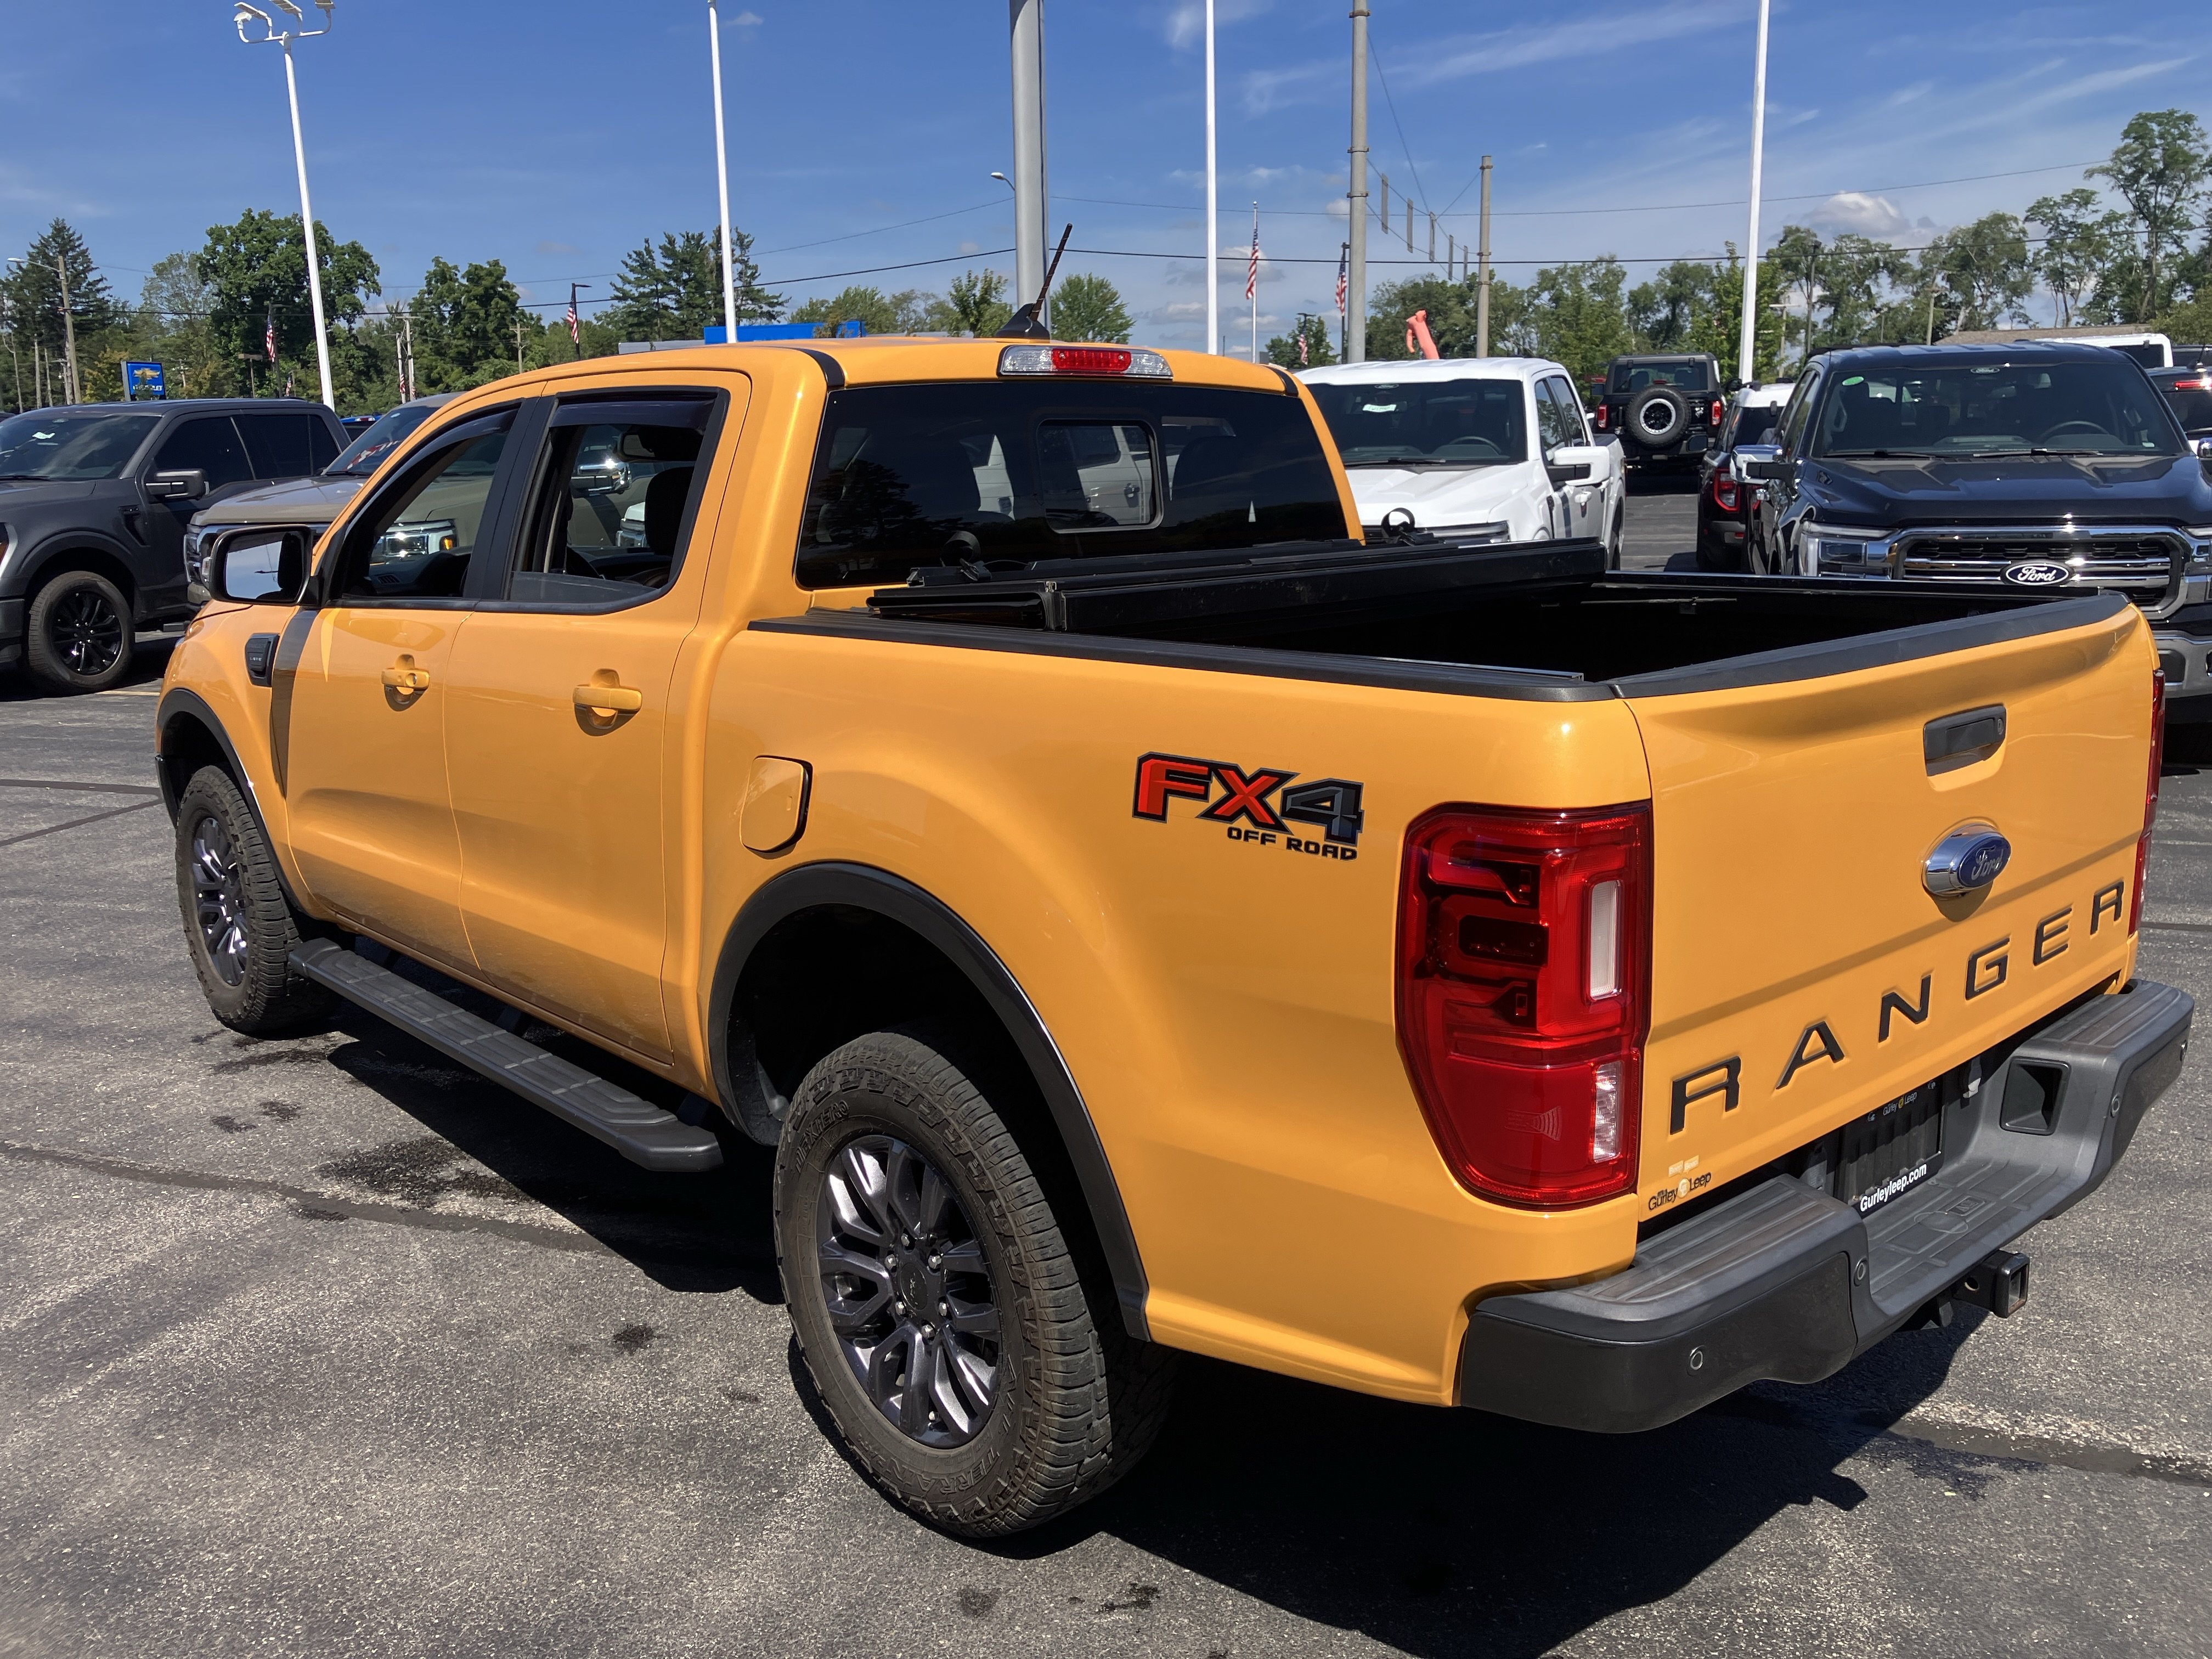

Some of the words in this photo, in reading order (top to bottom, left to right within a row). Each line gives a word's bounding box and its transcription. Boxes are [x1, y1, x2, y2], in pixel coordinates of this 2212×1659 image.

[2017, 566, 2057, 582] Ford
[1132, 752, 1364, 847] FX4
[1227, 827, 1277, 845] OFF
[1286, 836, 1358, 861] ROAD
[1971, 845, 2004, 881] Ford
[1670, 881, 2124, 1136] RANGER
[1649, 1188, 1678, 1210] Gurley
[1689, 1172, 1711, 1190] Leep
[1860, 1164, 1927, 1212] Gurleyleep.com
[889, 1447, 1000, 1494] TERRAIN
